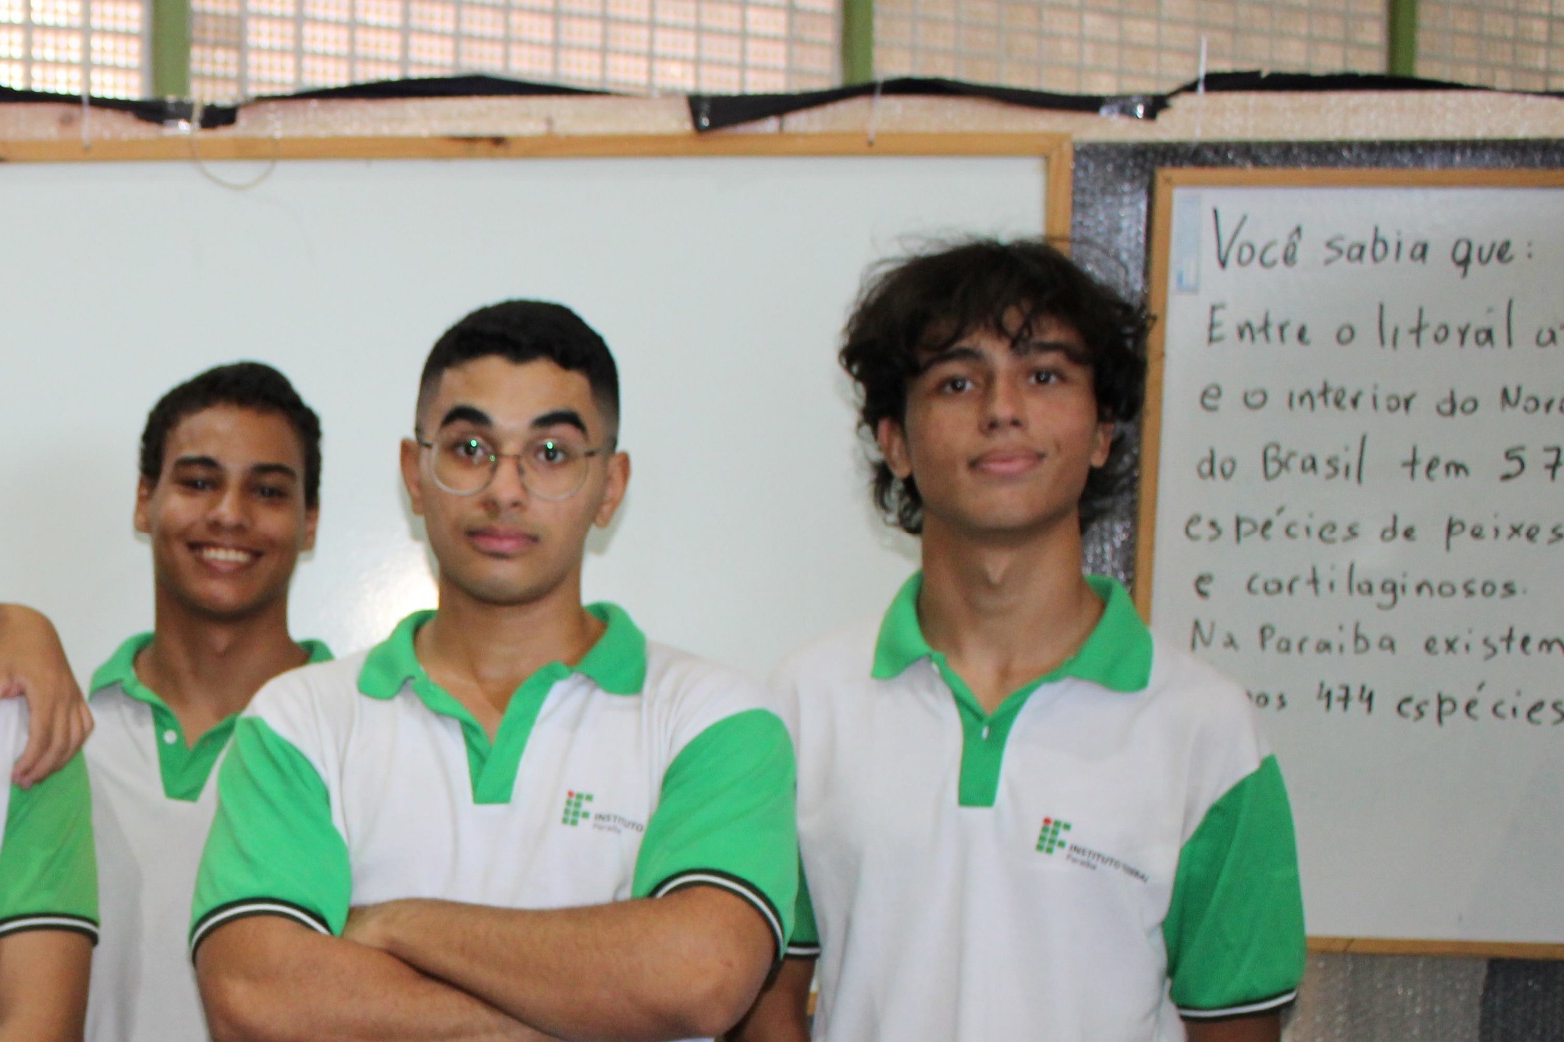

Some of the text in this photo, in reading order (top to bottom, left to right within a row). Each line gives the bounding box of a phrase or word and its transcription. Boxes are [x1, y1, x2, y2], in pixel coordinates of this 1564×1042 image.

[1213, 207, 1533, 279] Você sabia que:
[1207, 302, 1311, 347] Entre
[1335, 322, 1356, 347] o
[1199, 382, 1223, 411] e
[1243, 387, 1268, 410] o
[1288, 380, 1416, 413] interior
[1435, 388, 1480, 417] do
[1197, 446, 1236, 480] do
[1262, 433, 1367, 485] Brasil
[1401, 444, 1470, 481] tem
[1184, 506, 1564, 552] espécies de peixes
[1194, 572, 1214, 598] e
[1190, 617, 1240, 653] Na
[1317, 681, 1374, 714] 474
[1396, 681, 1564, 727] espécies
[594, 812, 643, 833] INSTITUTO
[1069, 844, 1121, 869] INSTITUTO
